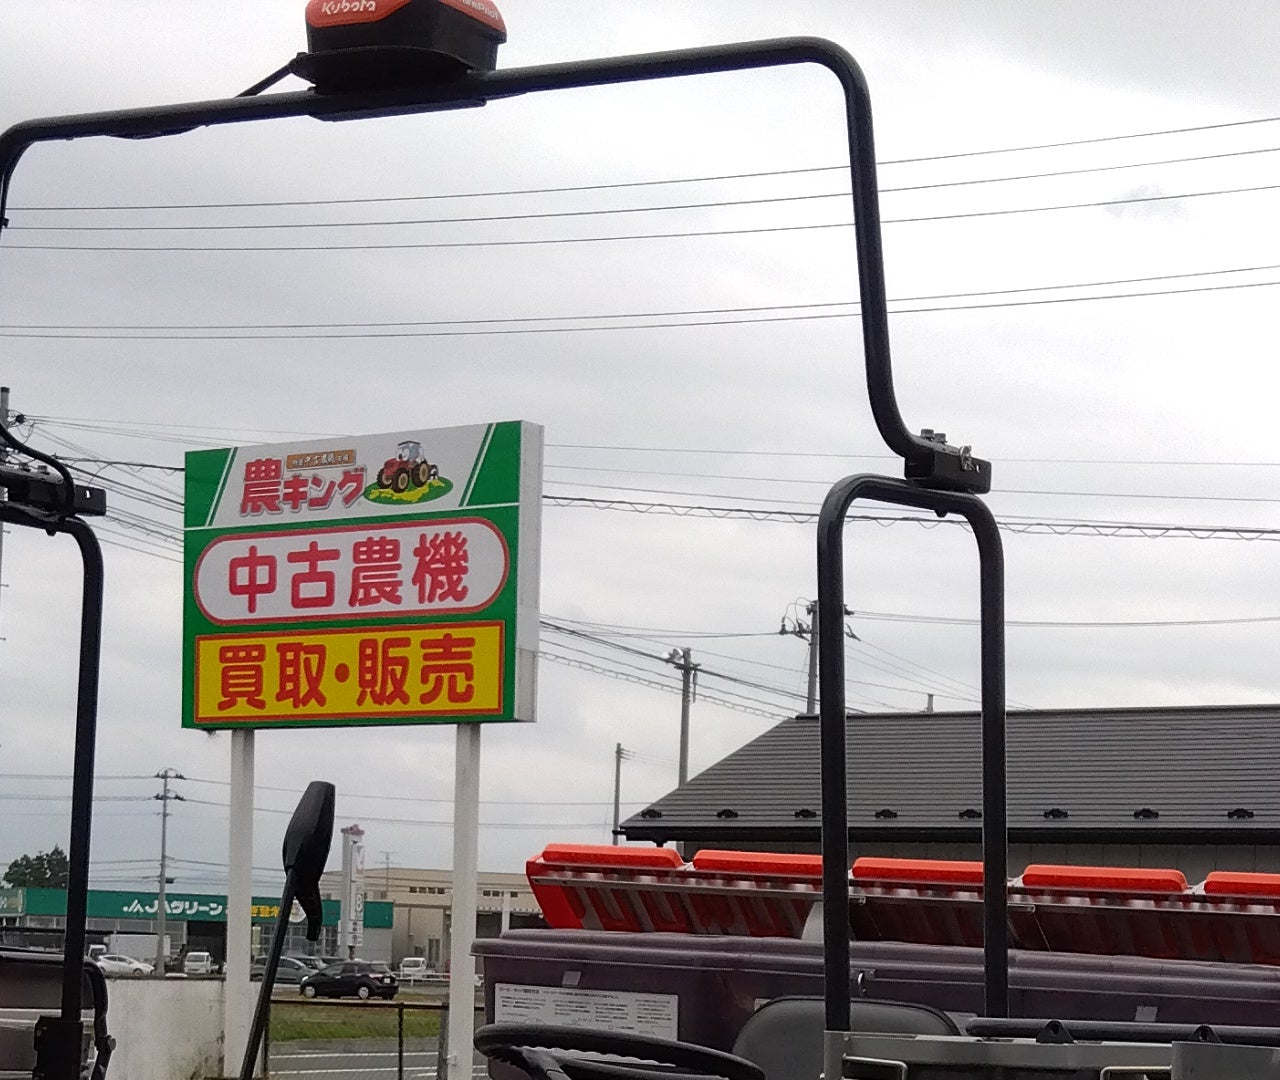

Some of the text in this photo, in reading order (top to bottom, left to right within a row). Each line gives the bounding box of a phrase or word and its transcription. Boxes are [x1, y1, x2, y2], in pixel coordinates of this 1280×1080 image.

[322, 0, 376, 14] Kubota
[240, 457, 367, 516] 農キング
[229, 531, 469, 613] 中古農機
[216, 633, 476, 711] 買取・販売
